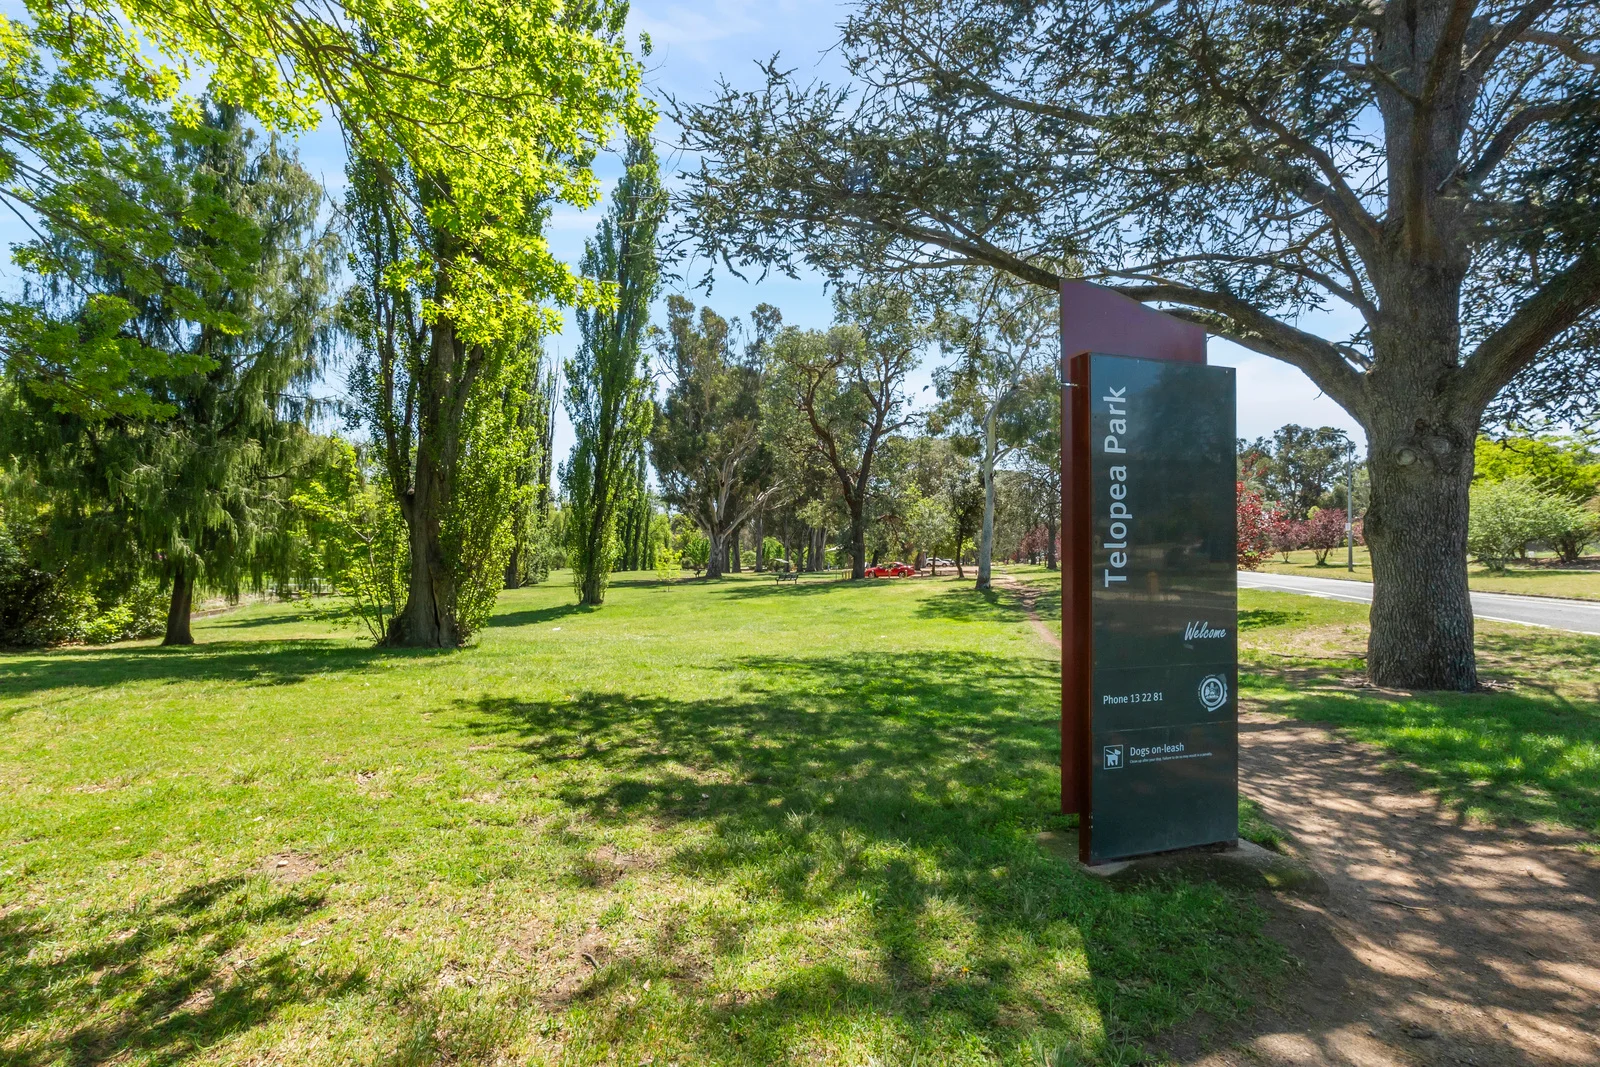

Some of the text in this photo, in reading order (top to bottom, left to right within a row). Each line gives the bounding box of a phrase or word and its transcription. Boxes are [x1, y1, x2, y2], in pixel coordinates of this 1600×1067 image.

[1103, 386, 1133, 588] Telopea Park
[1184, 620, 1227, 641] Welcome
[1103, 691, 1163, 705] Phone 13 22 81
[1130, 742, 1185, 757] Dogs on-leash
